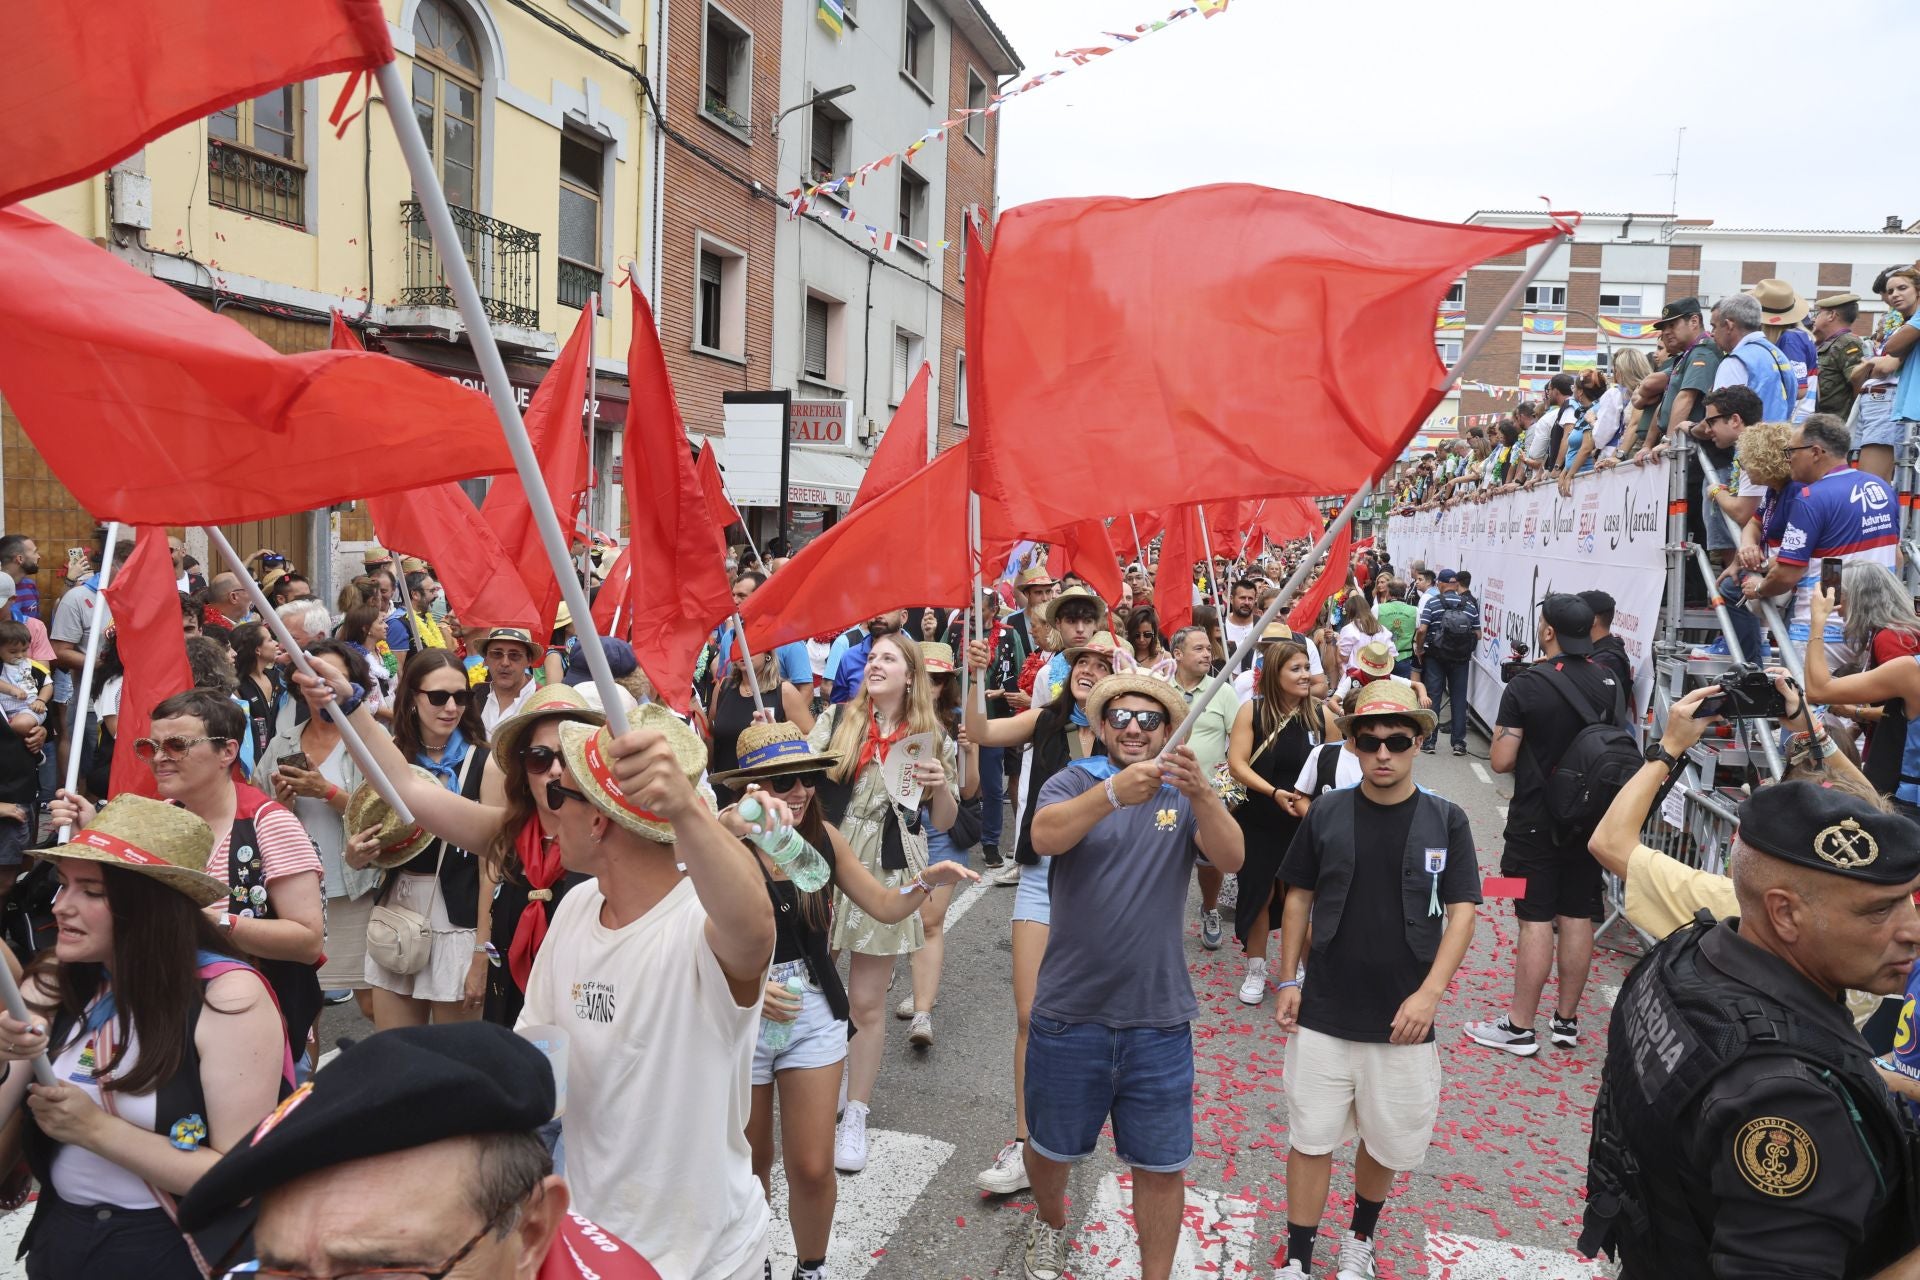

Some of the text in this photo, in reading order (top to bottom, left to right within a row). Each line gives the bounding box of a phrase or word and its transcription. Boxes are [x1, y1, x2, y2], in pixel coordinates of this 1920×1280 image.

[450, 377, 530, 408] OUUE
[582, 398, 600, 417] AZ
[790, 403, 842, 418] ERRETERÍA
[789, 421, 842, 441] FALO
[789, 487, 851, 504] ERRETERIA FALO
[1578, 512, 1597, 535] SELLA
[1604, 485, 1658, 550] casa Marcial
[1862, 513, 1891, 527] Asturias
[1484, 603, 1503, 642] SELLA
[1506, 611, 1525, 642] casa
[901, 763, 913, 797] QUESU
[586, 992, 616, 1023] VANS
[1747, 1120, 1812, 1148] GUARDIA CIVIL
